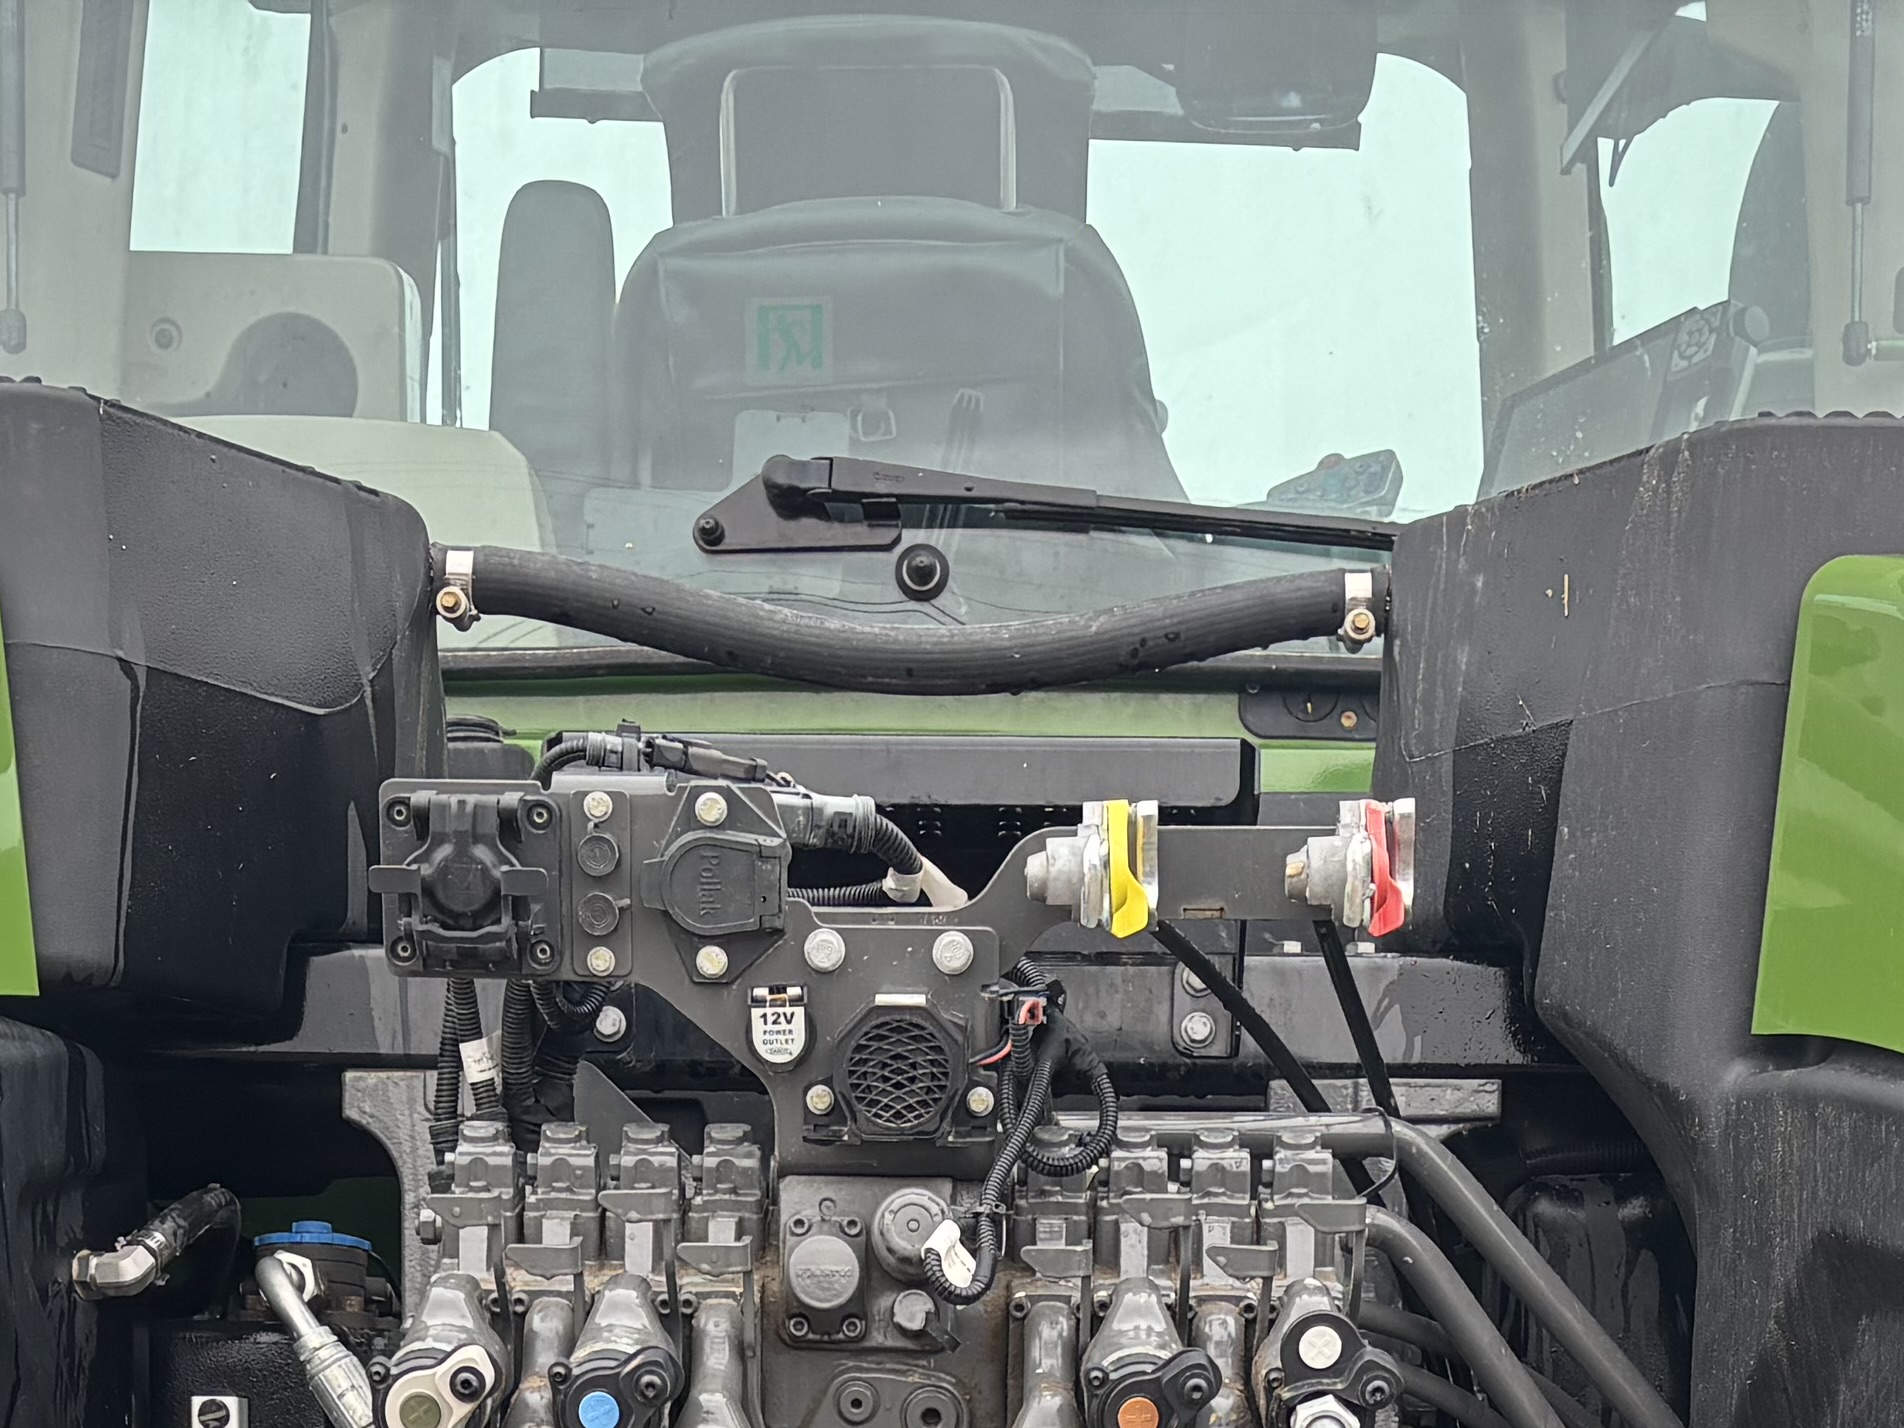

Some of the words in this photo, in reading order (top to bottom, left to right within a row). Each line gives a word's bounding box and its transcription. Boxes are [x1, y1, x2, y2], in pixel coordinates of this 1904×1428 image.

[699, 850, 722, 918] Pollak
[760, 1011, 795, 1026] 12V
[763, 1029, 794, 1037] POWER
[762, 1038, 795, 1046] OUTLET
